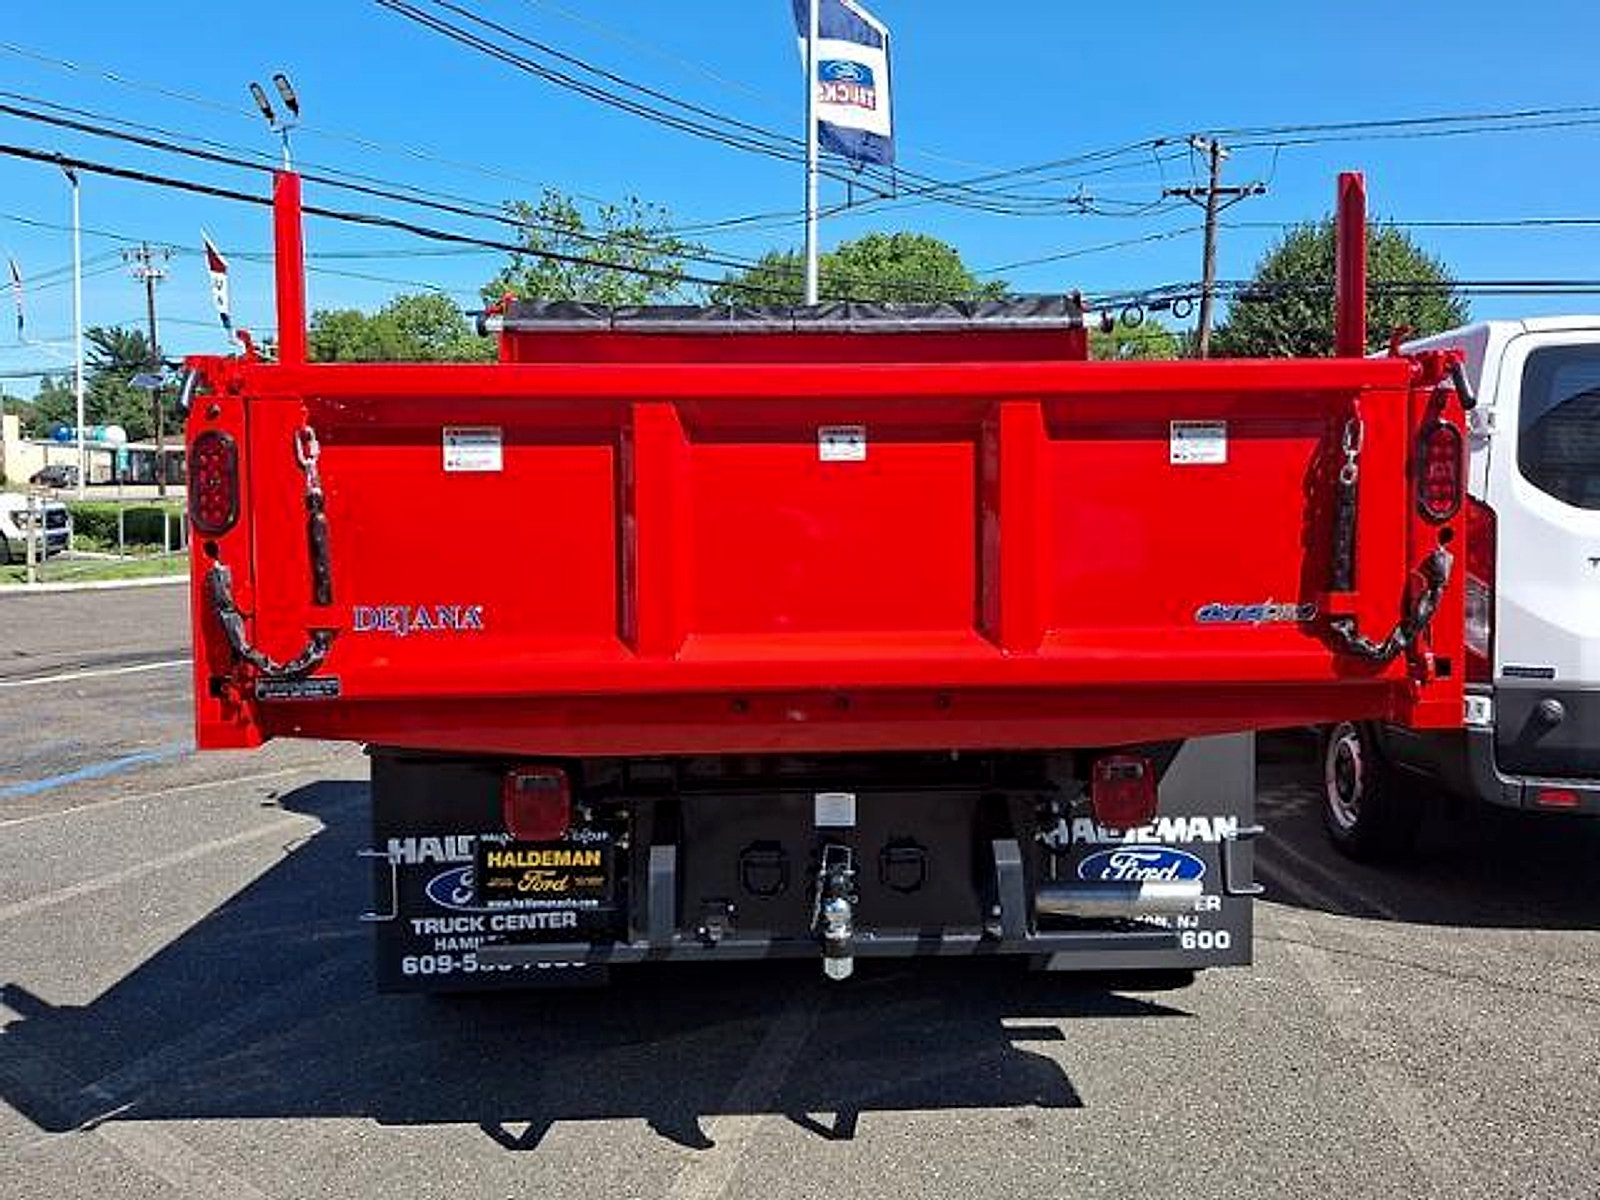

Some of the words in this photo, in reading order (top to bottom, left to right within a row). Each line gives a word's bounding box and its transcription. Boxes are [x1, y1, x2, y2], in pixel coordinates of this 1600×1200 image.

[353, 605, 484, 636] DEJANA
[487, 850, 601, 868] HALDEMAN
[517, 870, 569, 891] Ford
[411, 916, 485, 935] TRUCK
[490, 911, 577, 931] CENTER
